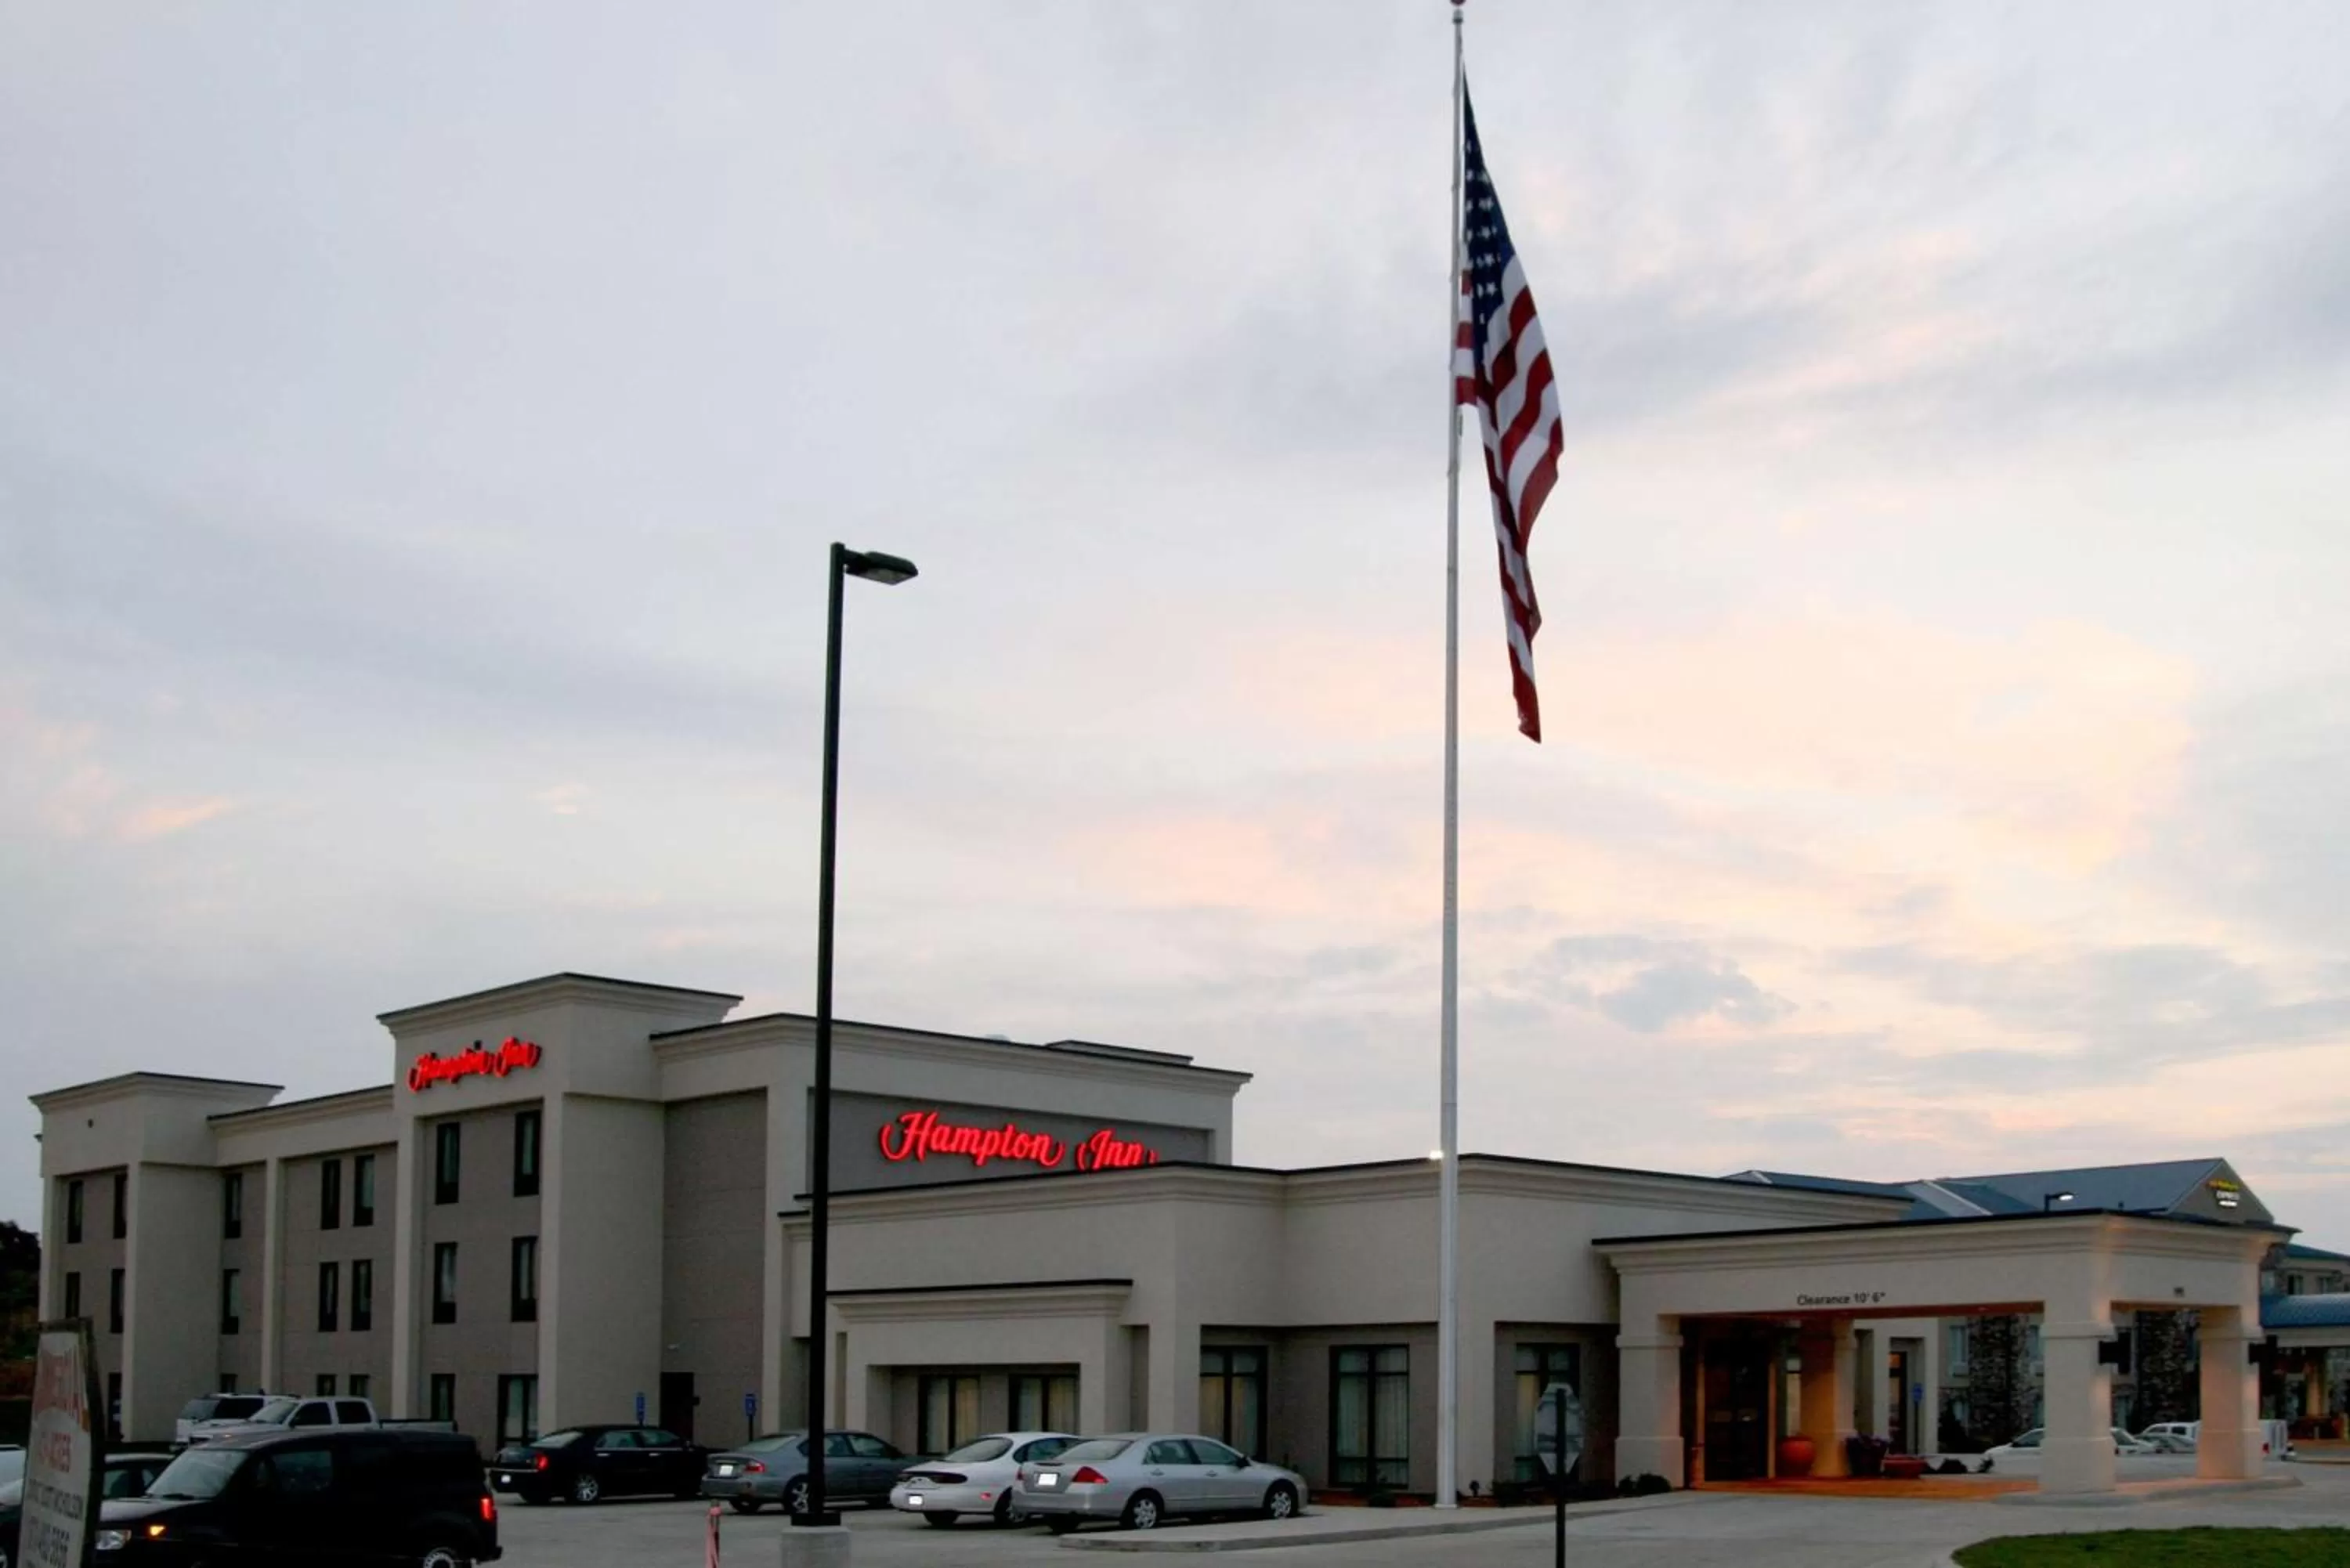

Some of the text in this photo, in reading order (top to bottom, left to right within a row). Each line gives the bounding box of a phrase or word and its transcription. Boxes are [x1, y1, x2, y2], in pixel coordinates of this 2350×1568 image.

[878, 1110, 1158, 1172] Hampton Inn
[1797, 1294, 1850, 1306] Clearance
